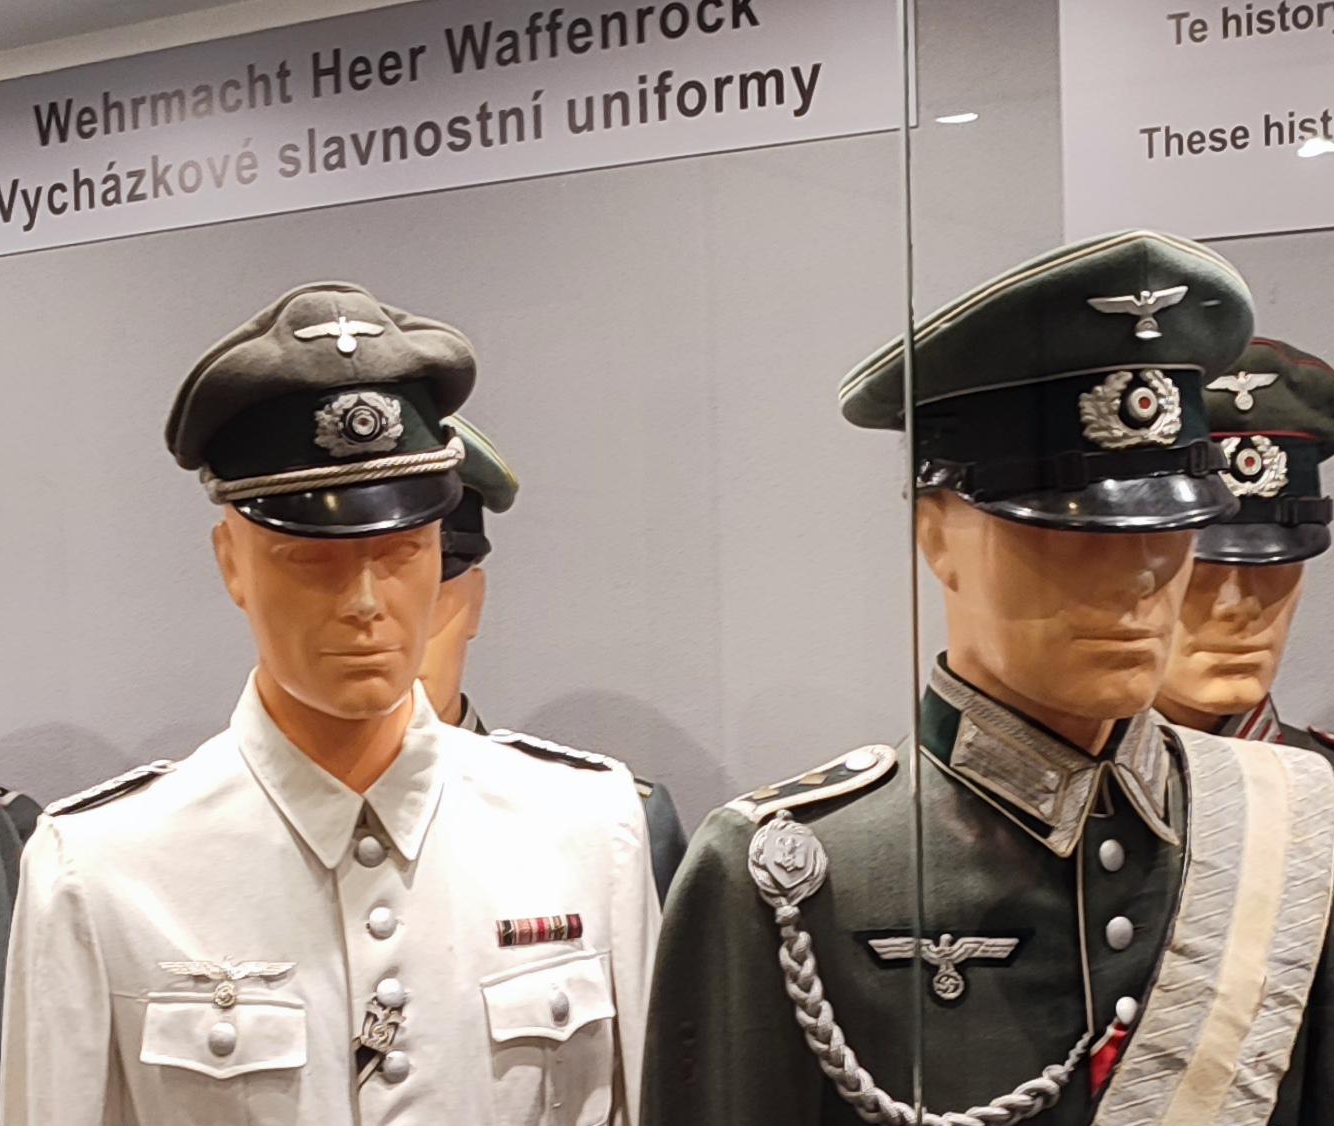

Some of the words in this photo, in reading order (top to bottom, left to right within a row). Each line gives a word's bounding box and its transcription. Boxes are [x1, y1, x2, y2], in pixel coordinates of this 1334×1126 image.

[1167, 12, 1209, 46] Te
[33, 59, 293, 147] Wehrmacht
[311, 45, 427, 98] Heer
[445, 0, 760, 74] Waffenrock
[278, 89, 545, 178] slavnostní
[567, 63, 823, 135] uniformy
[1139, 122, 1250, 160] These
